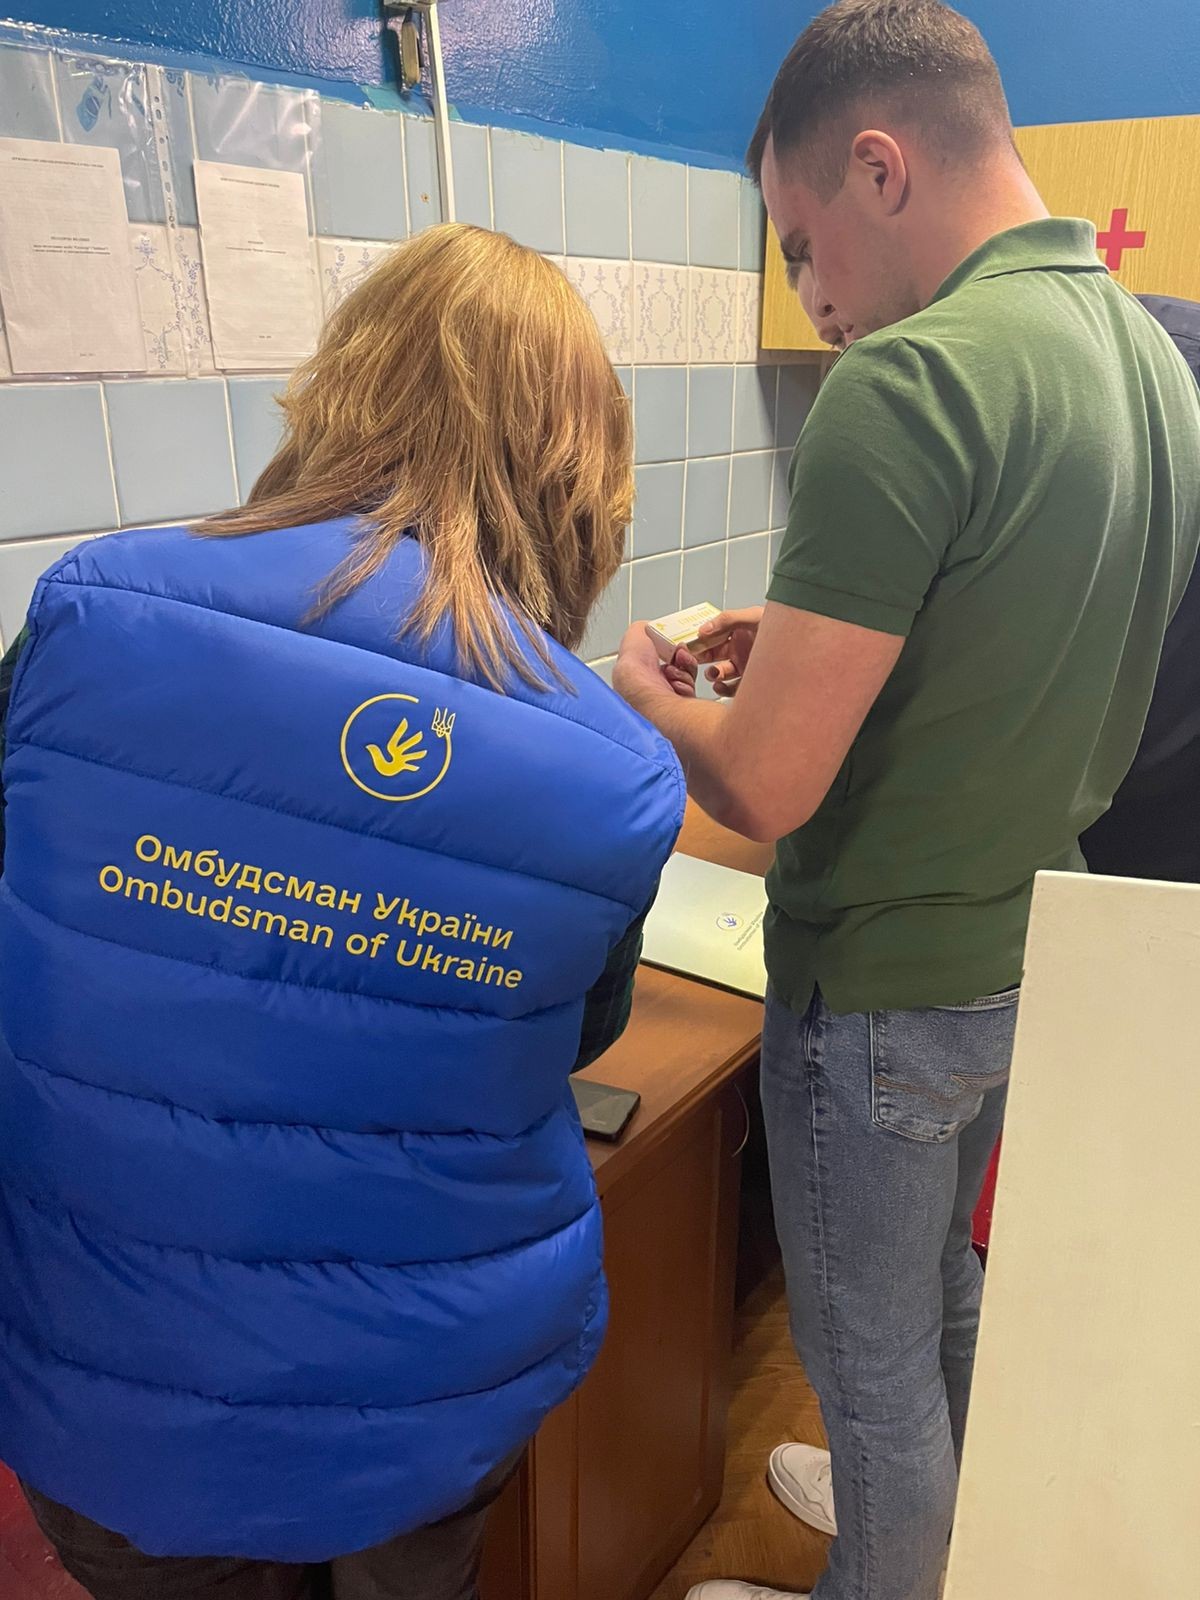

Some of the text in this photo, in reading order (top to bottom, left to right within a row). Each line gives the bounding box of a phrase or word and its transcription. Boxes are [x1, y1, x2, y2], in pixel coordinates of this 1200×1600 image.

[98, 865, 523, 989] Ombudsman of Ukraine
[134, 834, 513, 949] Омбудсман України
